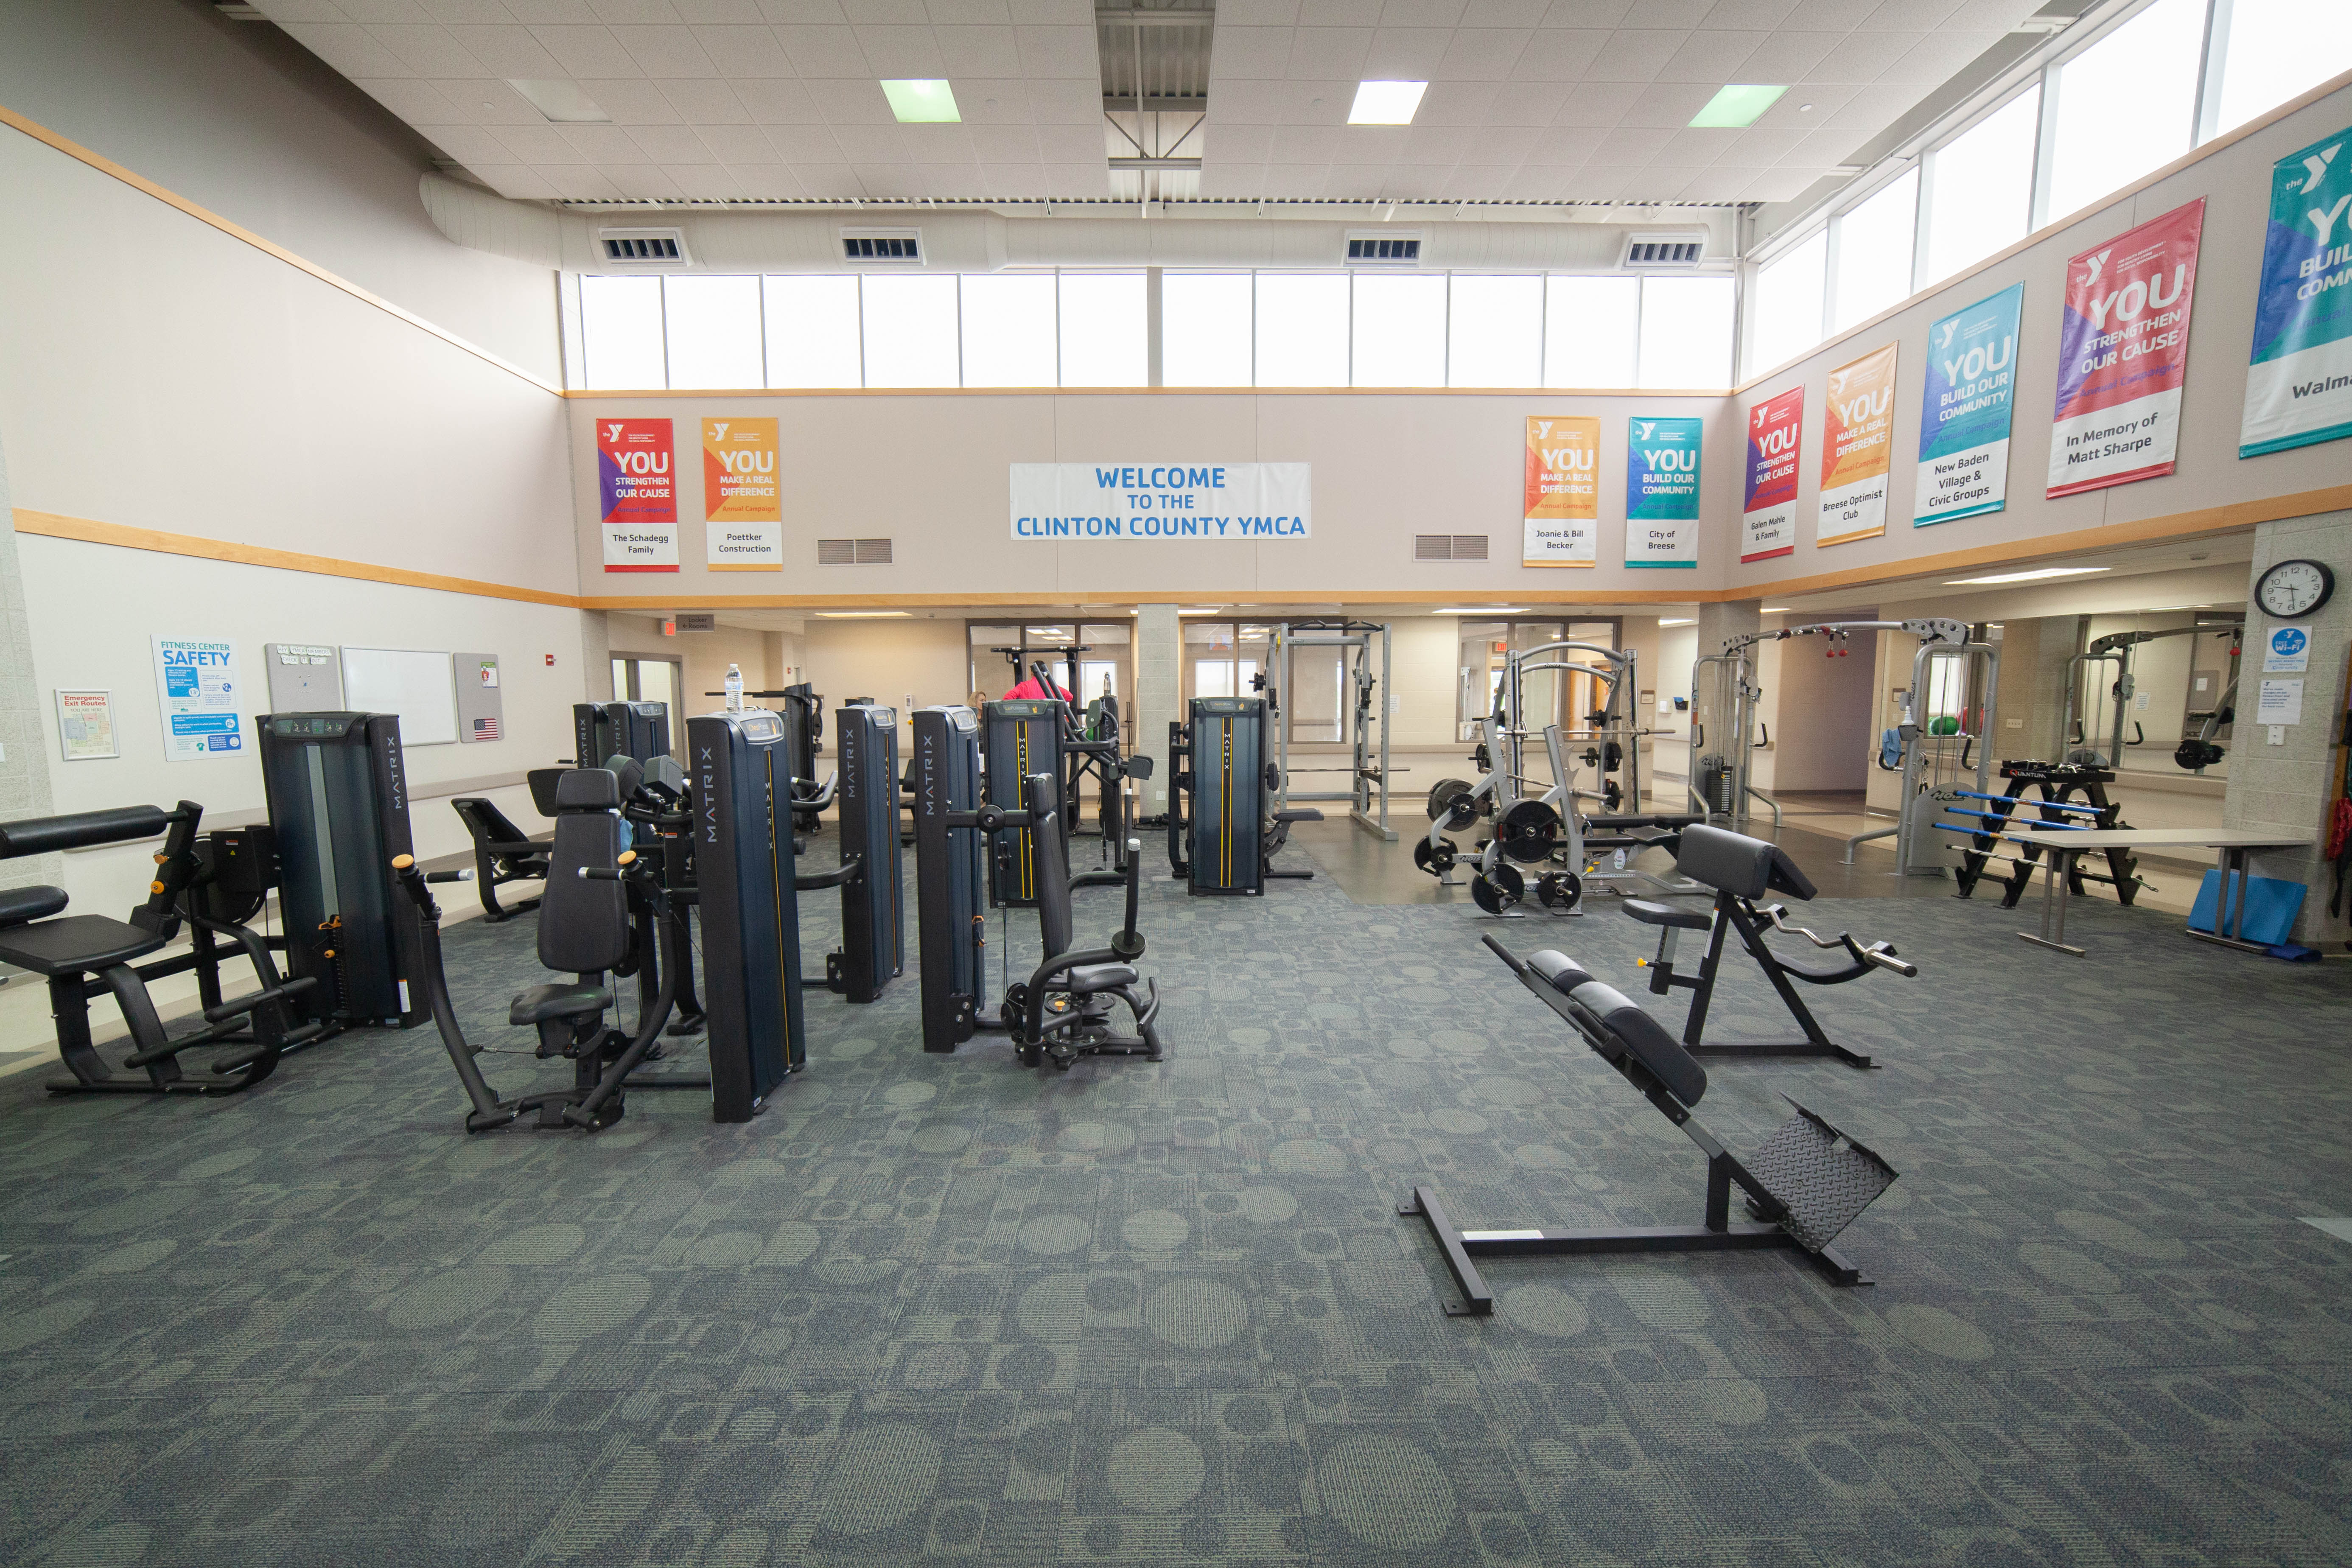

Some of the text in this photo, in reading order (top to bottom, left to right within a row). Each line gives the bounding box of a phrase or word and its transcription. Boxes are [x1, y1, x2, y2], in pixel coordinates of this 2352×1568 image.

[2286, 178, 2303, 190] the
[2076, 274, 2088, 283] the
[2090, 264, 2186, 331] YOU
[2084, 309, 2181, 354] STRENGTHEN
[1944, 335, 2011, 387] YOU
[2081, 330, 2179, 375] OUR CAUSE
[1940, 372, 2008, 406] BUILD OUR
[2079, 362, 2175, 398] Annual Campaign
[2293, 375, 2352, 399] Walm
[1840, 386, 1890, 428] YOU
[1939, 390, 2008, 422] COMMUNITY
[1758, 423, 1798, 458] YOU
[1837, 418, 1886, 443] MAKE A REAL
[1938, 418, 2005, 442] Annual Campaign
[2066, 412, 2159, 448] In Memory of
[1836, 431, 1886, 457] DIFFERENCE
[2067, 435, 2152, 466] Matt Sharpe
[614, 451, 669, 474] YOU
[720, 450, 773, 473] YOU
[1542, 448, 1594, 471] YOU
[1644, 449, 1696, 471] YOU
[1756, 451, 1795, 471] STRENGTHEN
[1835, 456, 1884, 476] Annual Campaign
[1934, 452, 1989, 475] New Baden
[615, 477, 669, 486] STRENGTHEN
[720, 476, 774, 484] MAKE A REAL
[1095, 468, 1225, 489] WELCOME
[1540, 473, 1593, 482] MAKE A REAL
[1643, 473, 1694, 483] BUILD OUR
[1756, 465, 1795, 484] OUR CAUSE
[1938, 470, 1982, 490] Village &
[616, 489, 670, 498] OUR CAUSE
[721, 487, 775, 496] DIFFERENCE
[1540, 485, 1593, 494] DIFFERENCE
[1642, 486, 1694, 494] COMMUNITY
[1929, 484, 1990, 507] Civic Groups
[1127, 494, 1194, 509] TO THE
[1823, 490, 1883, 512] Breese Optimist
[1017, 516, 1305, 536] CLINTON COUNTY YMCA
[1751, 515, 1786, 531] Galen Mahle
[1843, 510, 1859, 521] Club
[630, 534, 669, 544] Schadegg
[1536, 530, 1562, 538] Joanie
[1571, 530, 1584, 538] Bill
[1649, 531, 1665, 540] City
[1755, 529, 1780, 541] & Family
[627, 546, 654, 555] Family
[719, 545, 771, 553] Construction
[1546, 541, 1574, 549] Becker
[161, 641, 230, 651] FITNESS CENTER
[162, 650, 230, 666] SAFETY
[580, 719, 589, 767] MATRIX
[387, 736, 402, 809] MATRIX
[846, 728, 855, 798] MATRIX
[924, 735, 934, 815] MATRIX
[2009, 769, 2047, 779] QUANTUM
[701, 747, 717, 842] MATRIX
[764, 782, 773, 850] MATRIX
